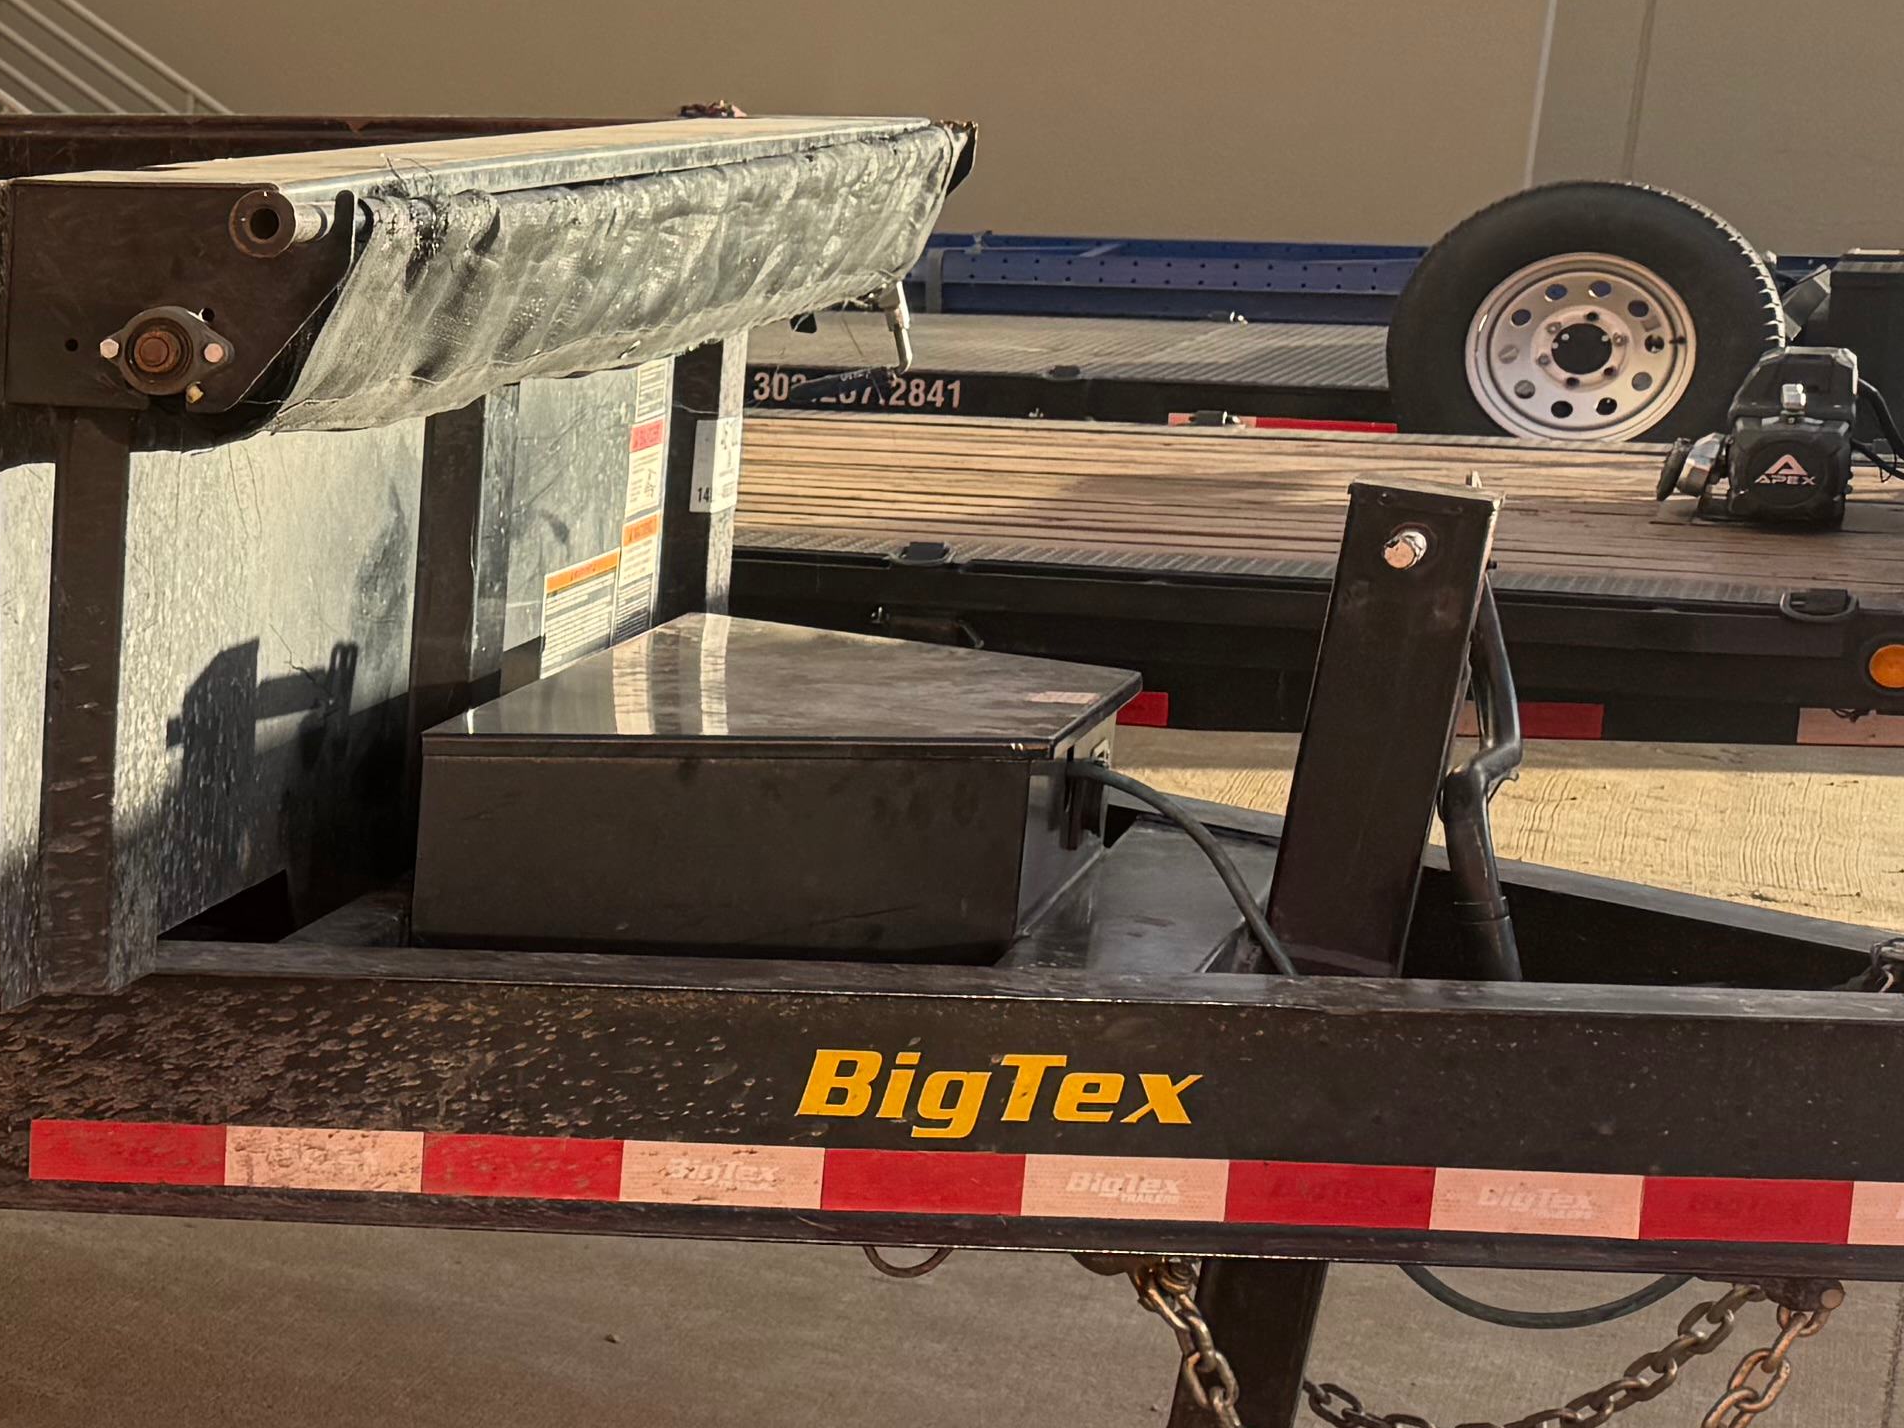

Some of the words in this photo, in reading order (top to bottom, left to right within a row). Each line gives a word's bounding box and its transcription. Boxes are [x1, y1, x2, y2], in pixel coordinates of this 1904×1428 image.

[1754, 474, 1816, 486] APEX
[794, 1048, 1204, 1139] BigTex
[1065, 1172, 1184, 1197] BigTex
